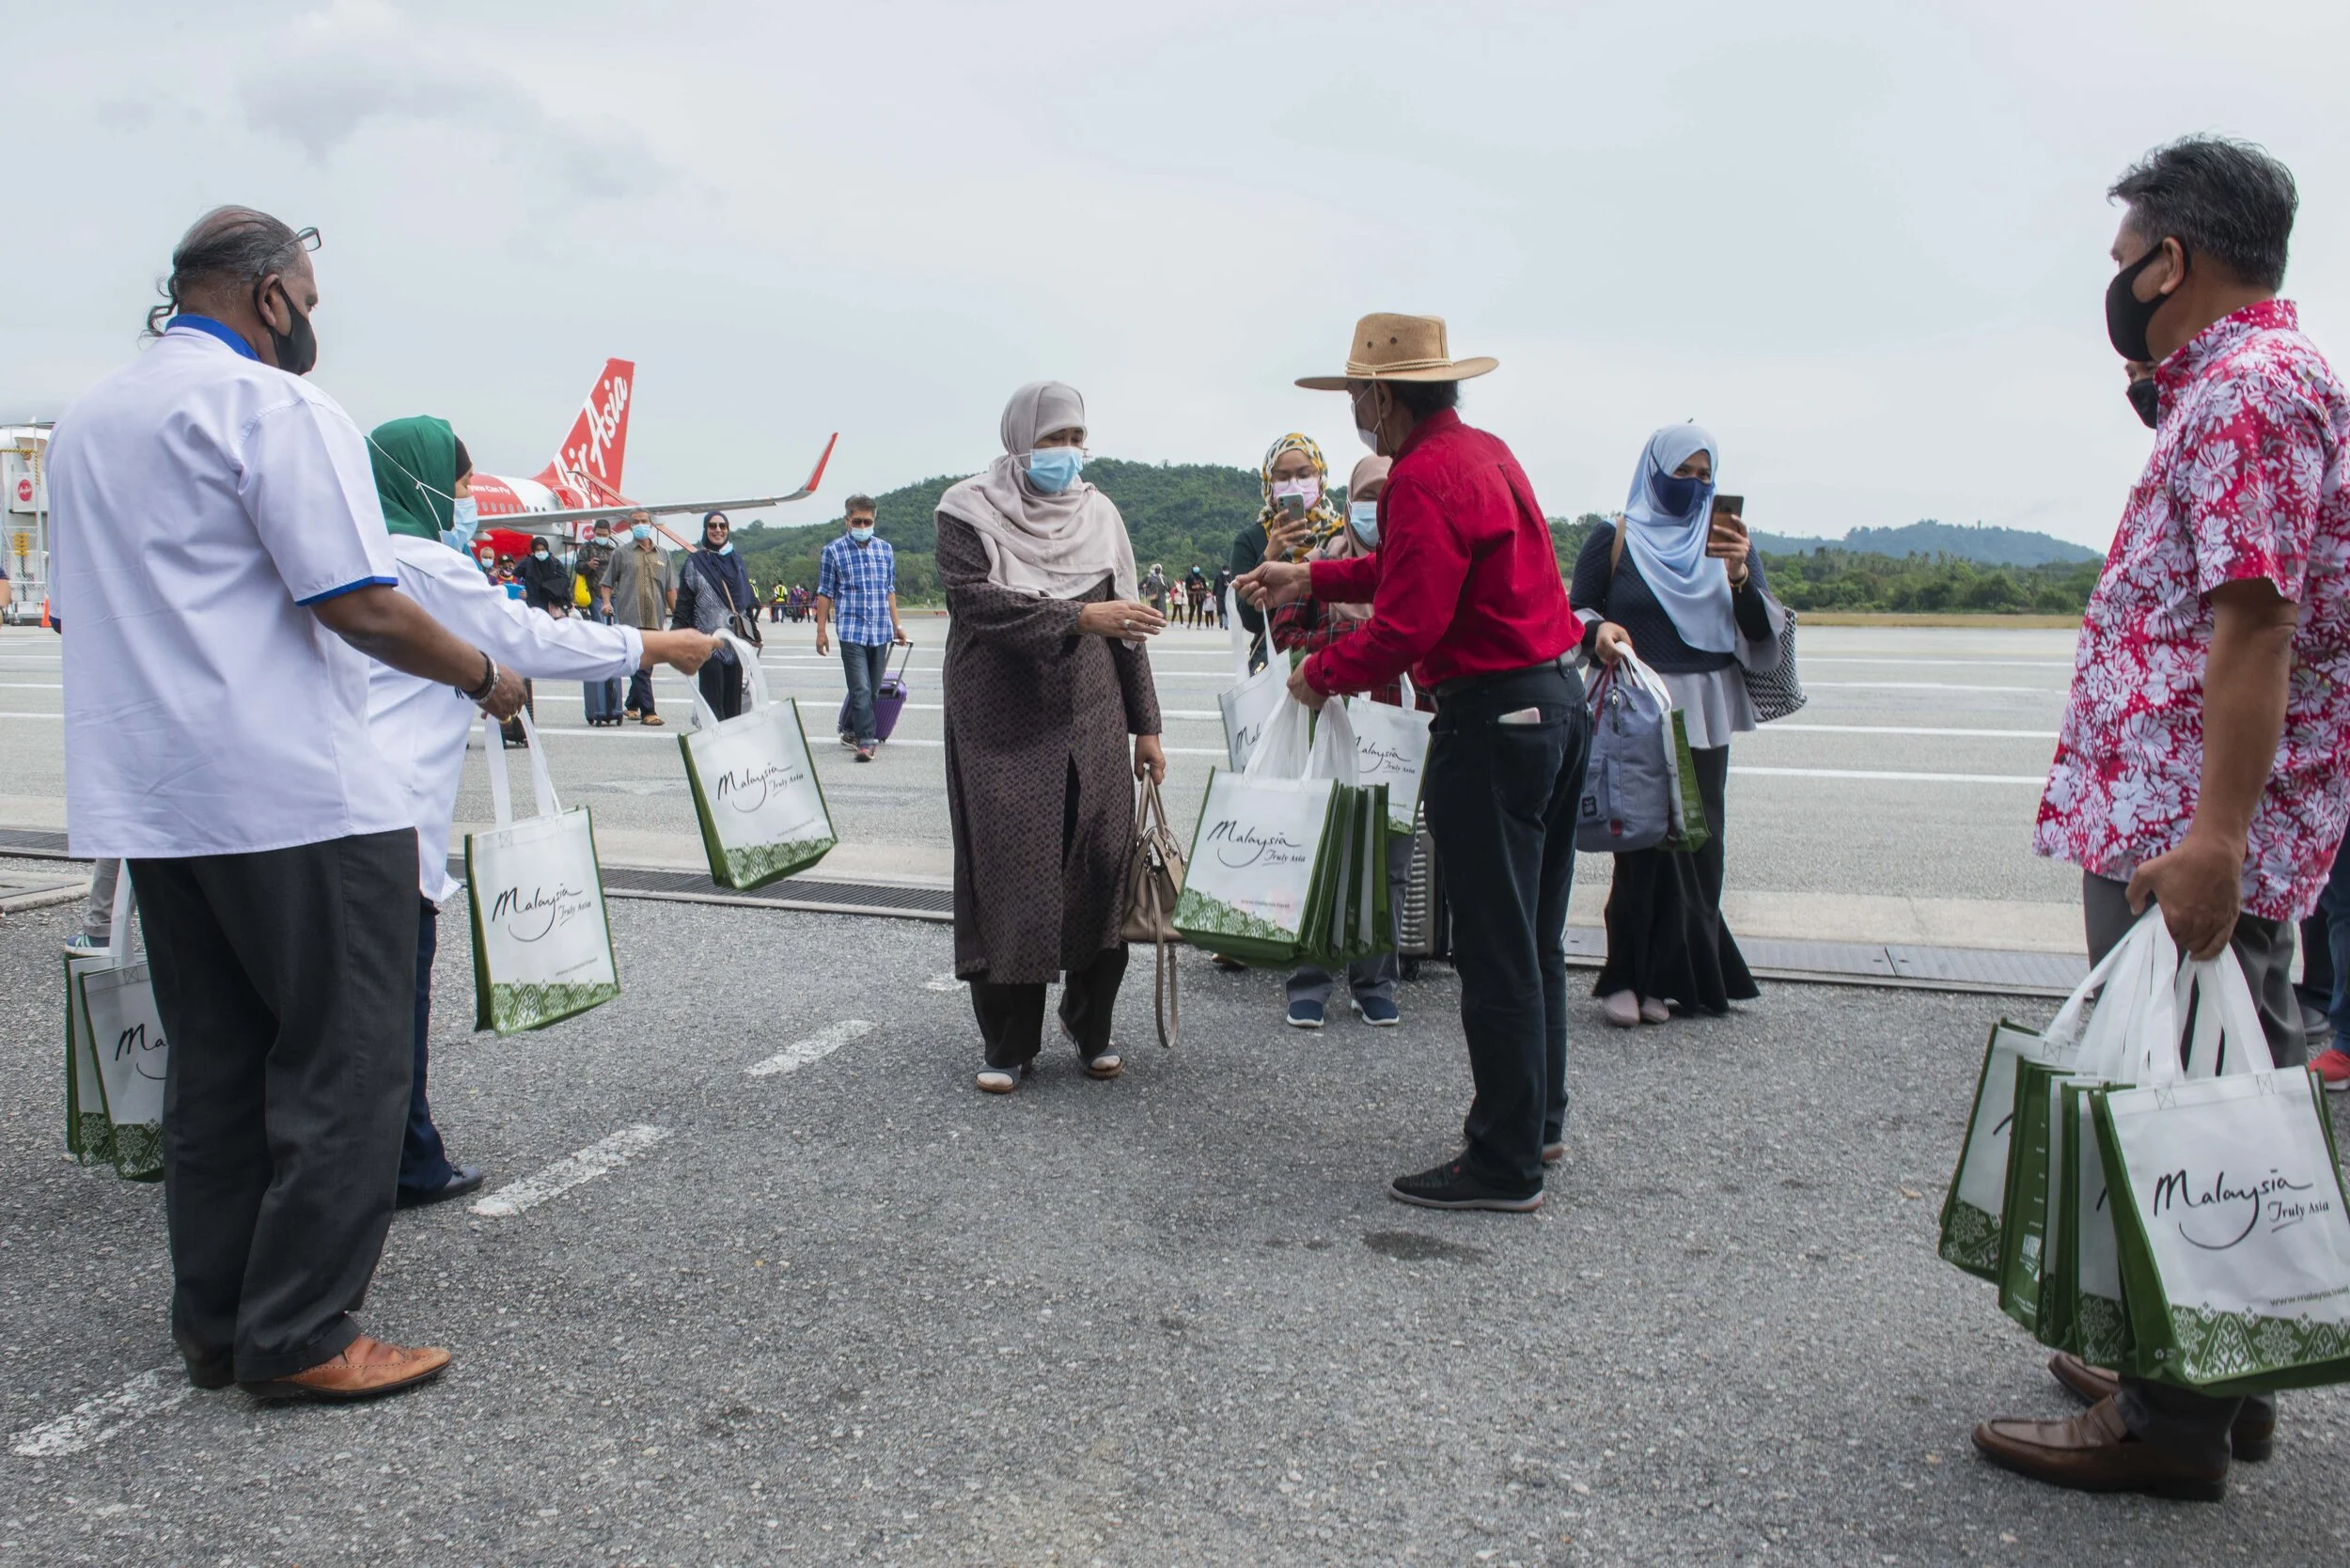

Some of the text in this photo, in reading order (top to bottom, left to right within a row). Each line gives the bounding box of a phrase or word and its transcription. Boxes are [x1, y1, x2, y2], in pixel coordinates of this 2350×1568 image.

[717, 762, 793, 814] Malaysia
[789, 773, 804, 784] Asia
[1207, 820, 1302, 869] Malaysia
[1263, 849, 1306, 865] Truly Asia
[492, 883, 583, 943] Malaysia
[558, 901, 592, 924] Truly Asia
[2154, 1168, 2313, 1250] Malaysia
[2267, 1200, 2329, 1229] Truly Asia
